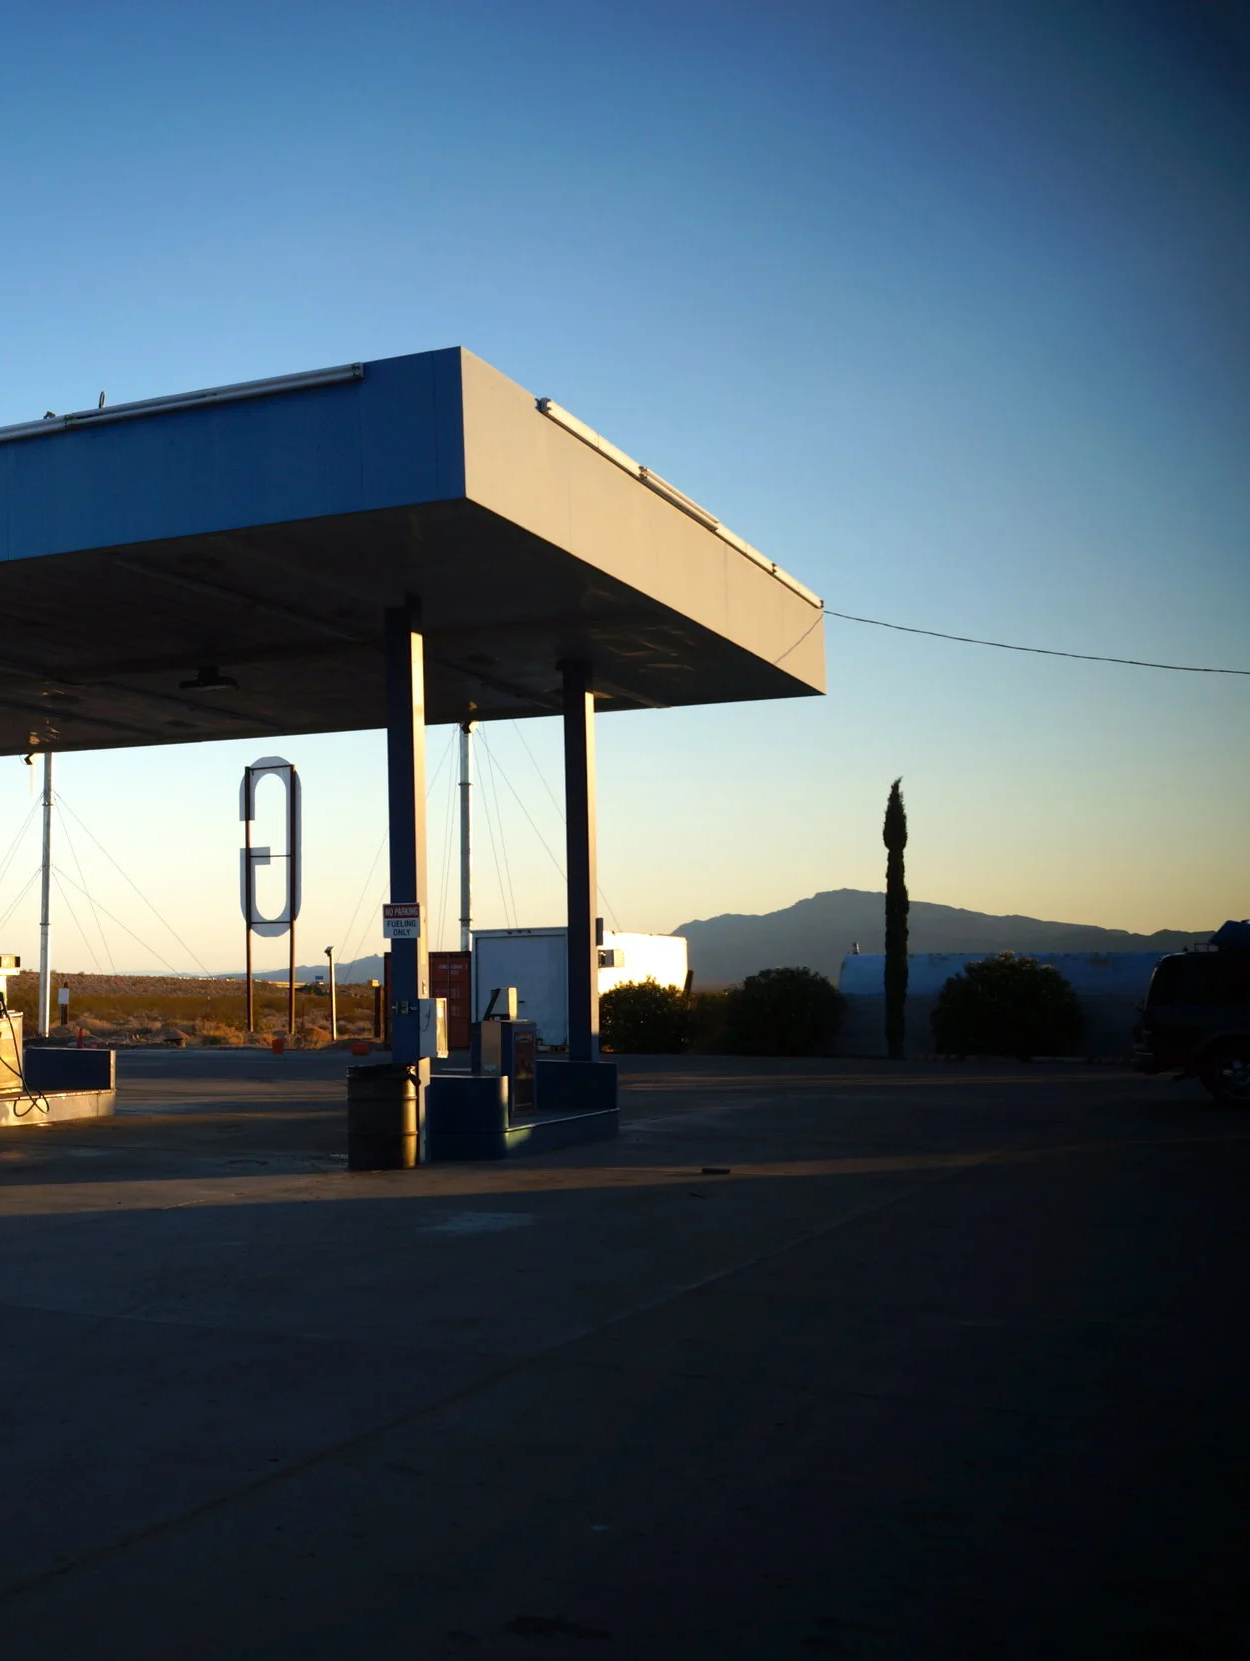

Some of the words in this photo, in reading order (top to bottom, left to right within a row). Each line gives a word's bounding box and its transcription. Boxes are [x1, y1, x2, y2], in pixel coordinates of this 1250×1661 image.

[385, 907, 393, 916] NO
[394, 907, 419, 917] PARKING
[387, 919, 416, 928] FUELING
